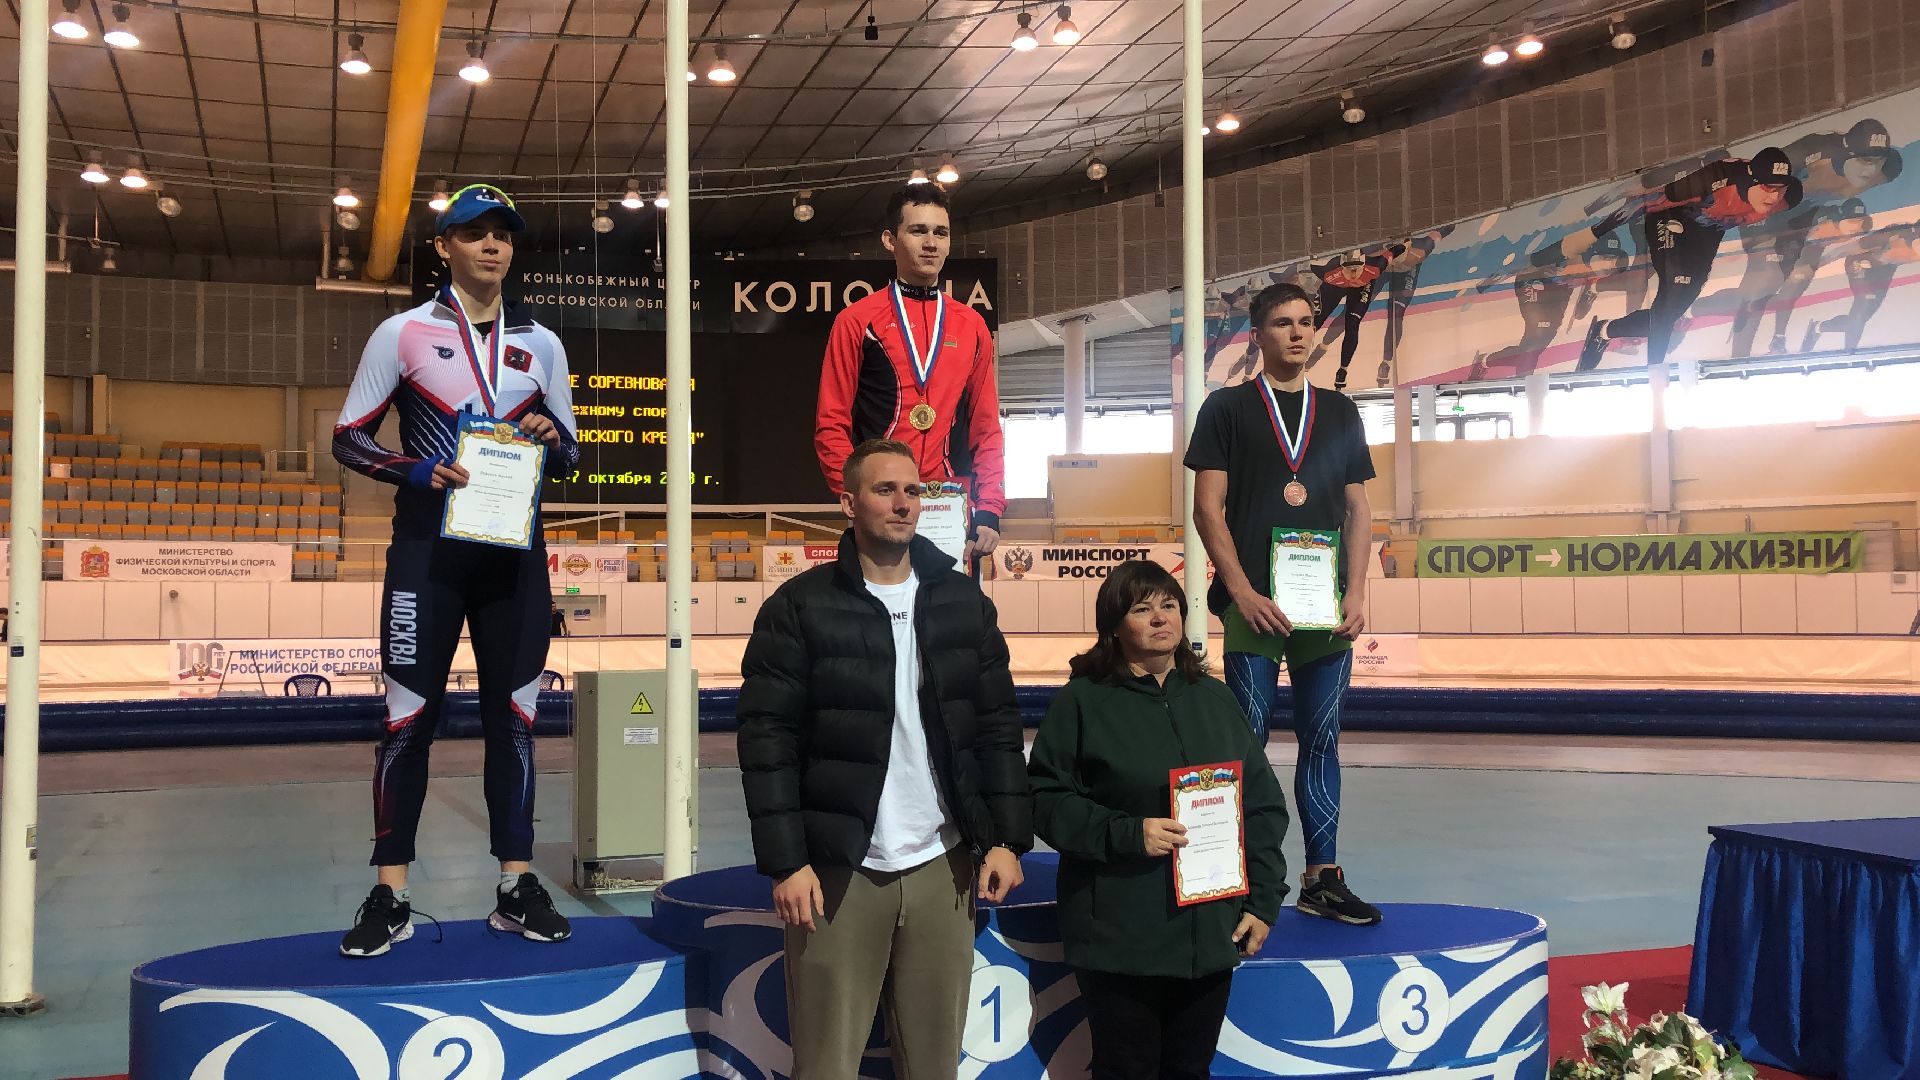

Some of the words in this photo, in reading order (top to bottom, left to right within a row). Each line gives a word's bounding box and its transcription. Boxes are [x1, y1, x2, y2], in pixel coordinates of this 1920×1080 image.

[523, 272, 650, 287] КОНЬКОБЕЖНЫЙ
[523, 294, 627, 308] МОСКОВСКОЙ
[636, 297, 700, 311] ОБЛИ
[734, 279, 993, 312] КОЛОА
[589, 375, 696, 391] СОРЕВНОВАЯ
[572, 405, 625, 418] ежному
[633, 407, 668, 418] спор
[478, 447, 522, 461] ДИПЛОМ
[588, 471, 652, 485] октября
[704, 475, 720, 485] г.
[158, 548, 233, 556] МИНИСТЕРСТВО
[811, 549, 838, 557] СПОР
[1042, 548, 1151, 561] МИНСПОРТ
[1288, 553, 1321, 562] ДИПЛОМ
[1427, 544, 1534, 574] СПОРТ
[1567, 541, 1702, 572] НОРМА
[1709, 537, 1852, 571] ЖИЗНИ
[115, 557, 181, 566] ФИЗИЧЕСКОЙ
[182, 558, 230, 566] КУЛЬТУРЫ
[240, 559, 276, 567] СПОРТА
[141, 567, 207, 576] МОСКОВСКОЙ
[208, 568, 251, 577] ОБЛАСТИ
[1058, 565, 1118, 579] РОССИ
[388, 590, 417, 665] МОСКВА
[176, 642, 224, 671] 100
[239, 648, 345, 661] МИНИСТЕРСТВО
[348, 648, 381, 659] СПОР
[230, 661, 319, 675] РОССИЙСКОЙ
[1191, 796, 1225, 810] ДИПЛОМ
[981, 985, 1001, 1043] 1
[1402, 984, 1430, 1036] 3
[433, 1037, 473, 1080] 2
